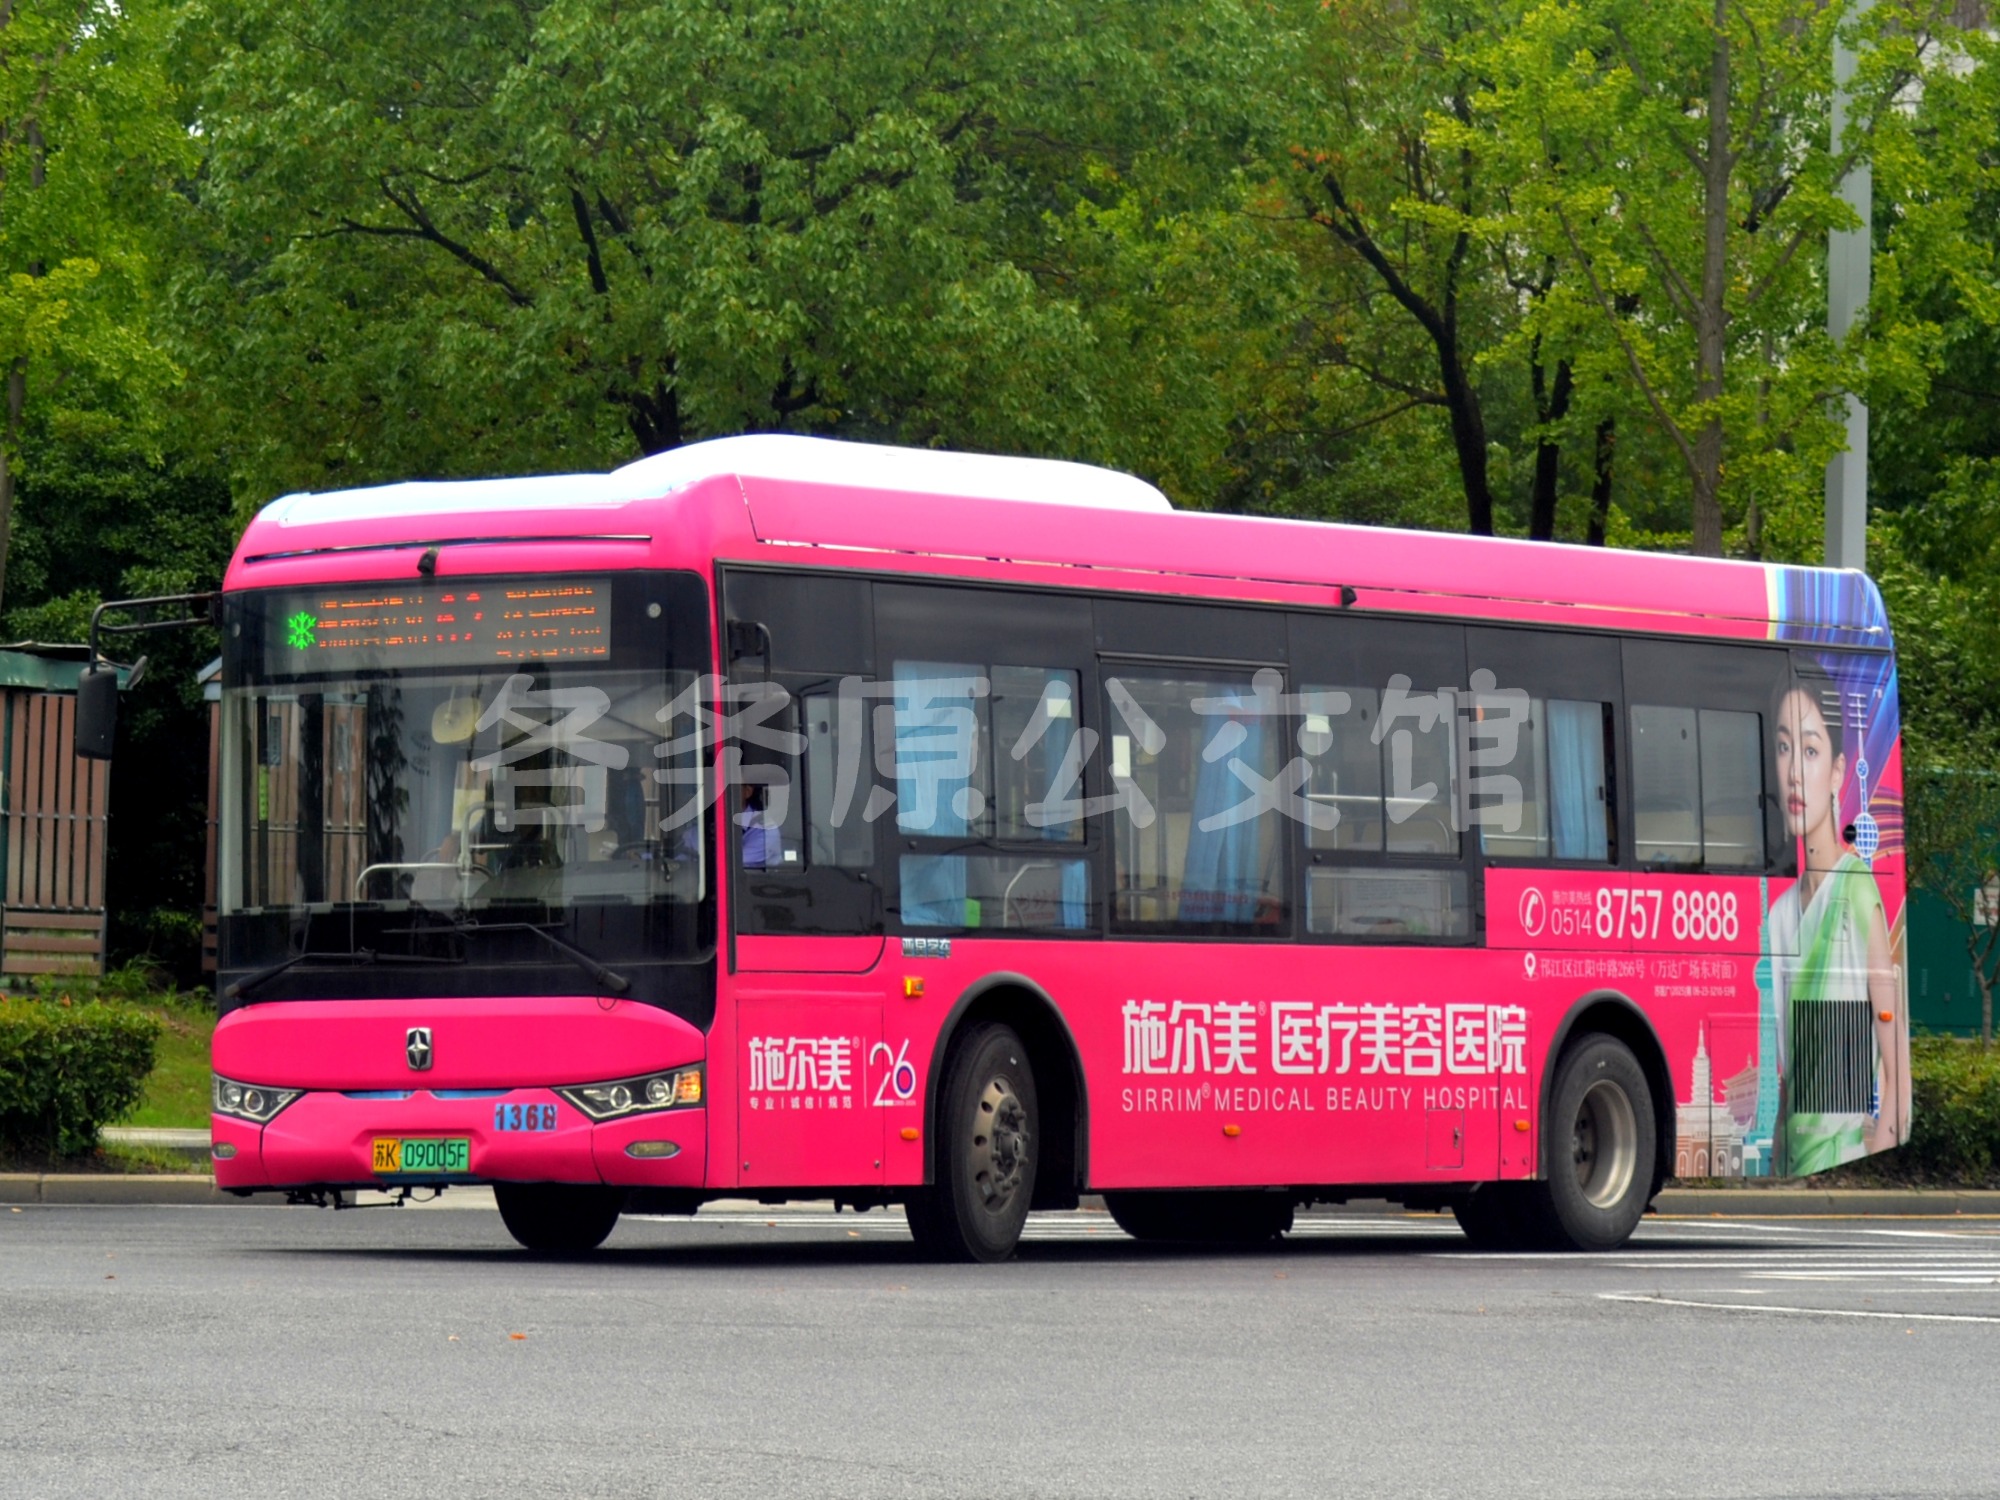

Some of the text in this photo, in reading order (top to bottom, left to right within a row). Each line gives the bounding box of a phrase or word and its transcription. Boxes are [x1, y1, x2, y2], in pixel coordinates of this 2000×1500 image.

[1551, 887, 1739, 941] 0514 8757 8888
[869, 1038, 917, 1106] 26
[1214, 1087, 1315, 1112] MEDICAL
[1326, 1087, 1412, 1111] BEAUTY
[1423, 1086, 1528, 1110] HOSPITAL
